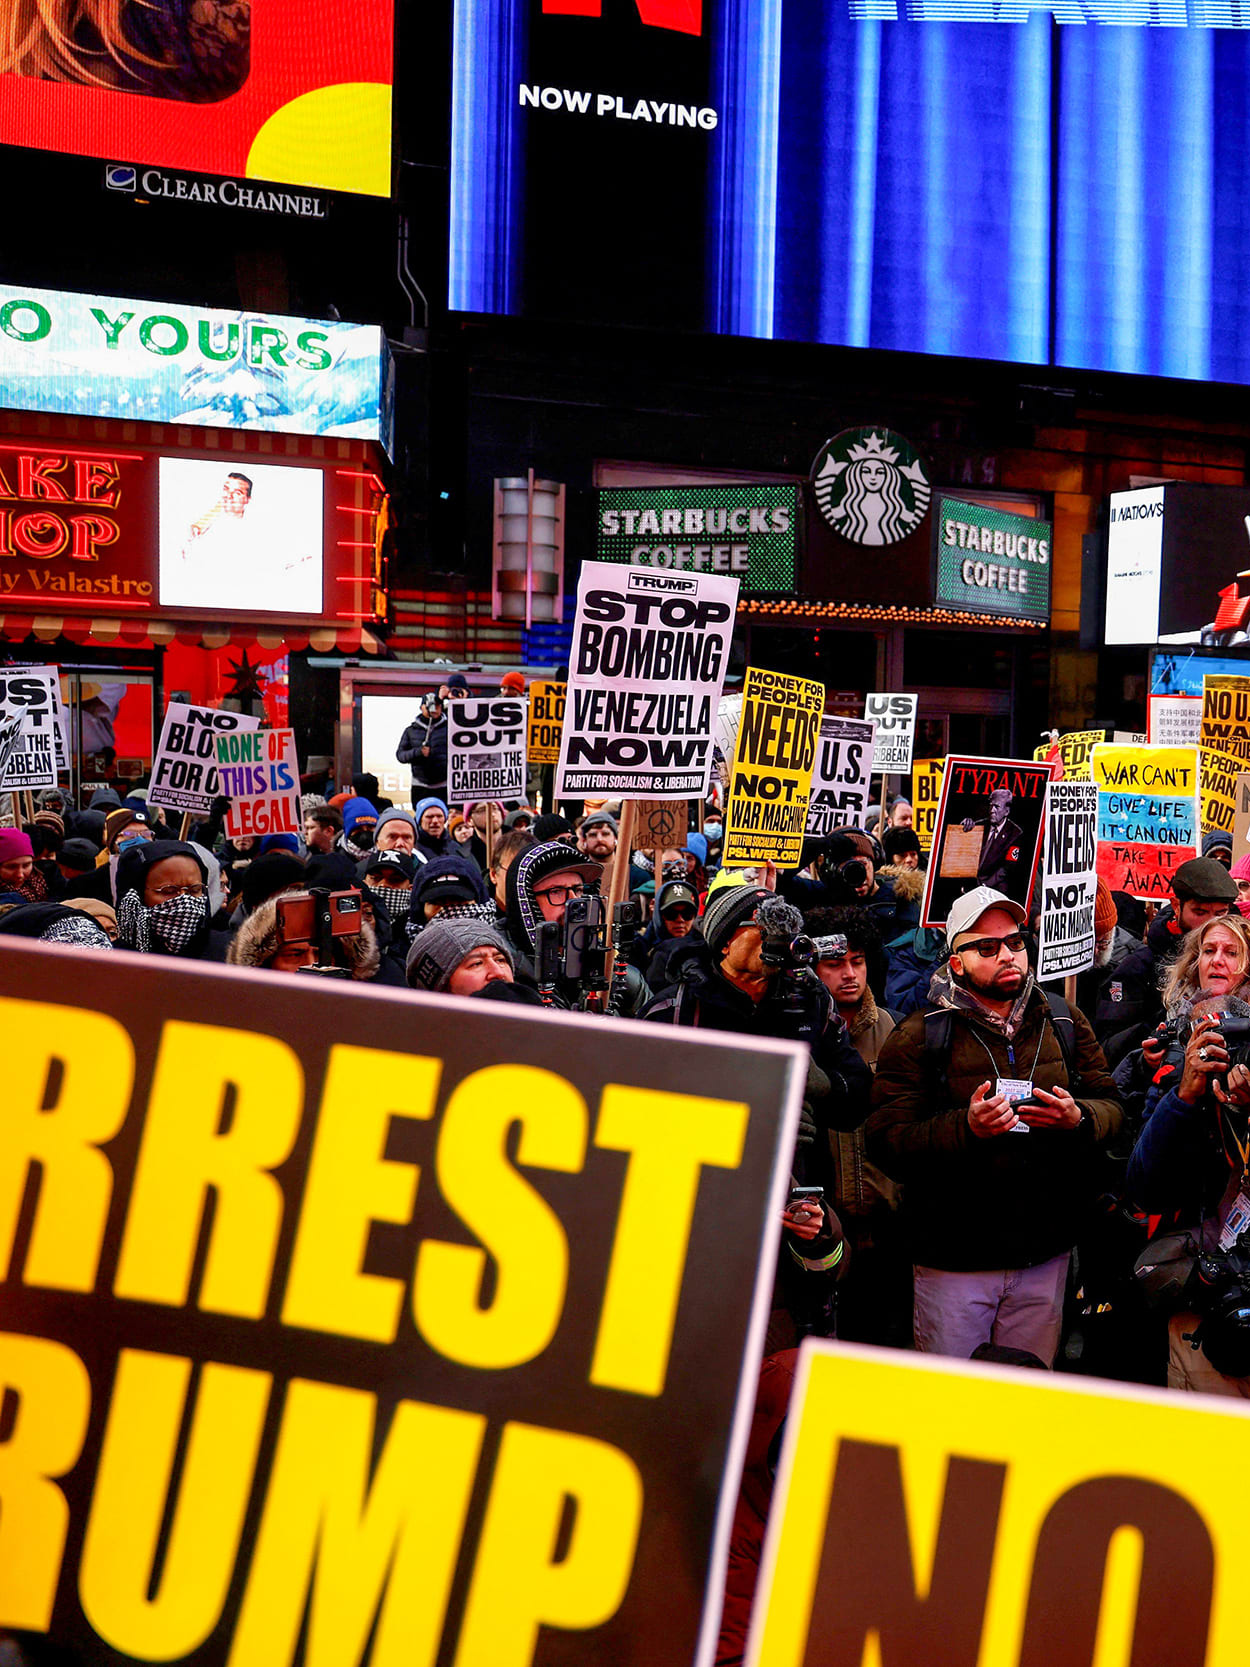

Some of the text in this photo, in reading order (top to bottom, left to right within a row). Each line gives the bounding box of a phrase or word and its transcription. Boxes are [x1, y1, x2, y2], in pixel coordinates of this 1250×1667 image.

[519, 84, 718, 131] NOW PLAYING
[88, 306, 335, 373] YOURS
[601, 505, 791, 537] STARBUCKS
[630, 543, 750, 572] COFFEE
[943, 518, 1049, 566] STARBUCKS
[27, 568, 153, 597] Valastro
[961, 556, 1029, 595] COFFEE
[583, 589, 731, 630] STOP
[576, 622, 724, 684] BOMBING
[746, 684, 823, 711] PEOPLE'S
[749, 670, 823, 697] MONEY FOR
[452, 702, 523, 728] US
[573, 687, 711, 736] VENEZUELA
[867, 696, 914, 716] US
[1203, 690, 1232, 720] NO
[216, 731, 292, 764] NONE OF
[452, 729, 523, 748] OUT
[738, 700, 819, 772] NEEDS
[451, 753, 467, 770] OF
[504, 751, 522, 768] THE
[565, 736, 710, 768] NOW!
[820, 741, 866, 785] U.S.
[155, 757, 203, 793] FOR
[218, 762, 295, 796] THIS IS
[451, 767, 523, 790] CARIBBEAN
[733, 772, 808, 804] NOT THE
[953, 767, 1045, 800] TYRANT
[1100, 761, 1191, 788] WAR CAN'T
[1049, 798, 1097, 812] PEOPLE'S
[1050, 785, 1097, 798] MONEY FOR
[1108, 795, 1142, 815] GIVE
[227, 796, 298, 838] LEGAL
[731, 799, 806, 833] WAR MACHINE
[634, 832, 686, 848] FOR OIL
[1047, 812, 1096, 875] NEEDS
[1102, 823, 1192, 847] IT CAN ONLY
[727, 847, 799, 862] PSLWEB.ORG
[1111, 846, 1177, 868] TAKE IT
[1123, 868, 1176, 894] AWAY
[1045, 882, 1087, 912] NOT
[1043, 904, 1094, 944] WAR MACHINE
[1042, 951, 1094, 974] PSLWEB.ORG
[799, 1437, 1215, 1667] NO
